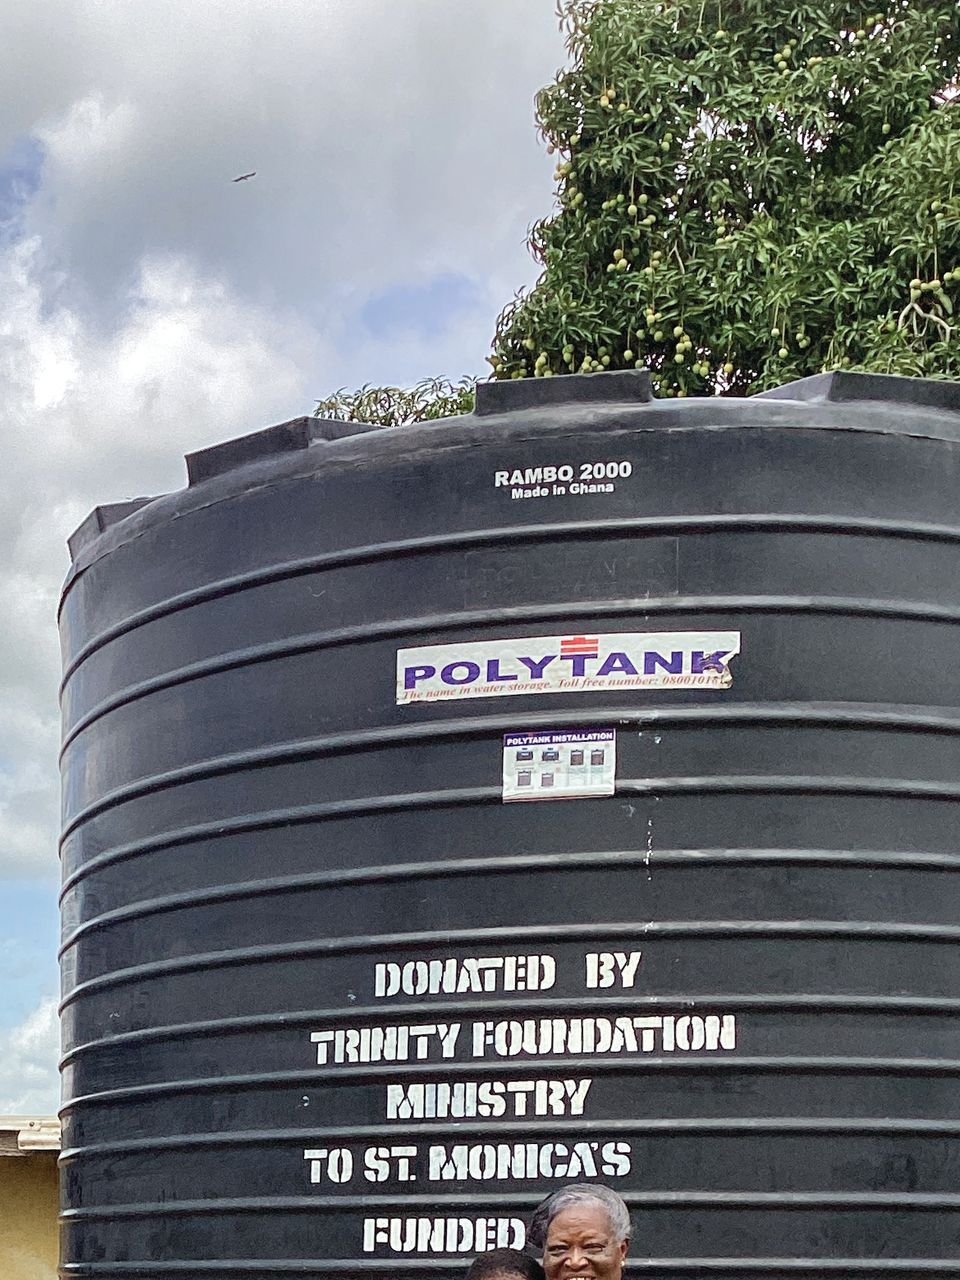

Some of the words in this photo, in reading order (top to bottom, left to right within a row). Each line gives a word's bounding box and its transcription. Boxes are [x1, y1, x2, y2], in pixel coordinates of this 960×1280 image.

[494, 465, 574, 487] RAMBO
[579, 461, 632, 480] 2000
[511, 487, 549, 499] Made
[553, 485, 566, 495] in
[569, 482, 614, 495] Ghana
[402, 690, 424, 699] The
[426, 688, 457, 698] name
[460, 686, 472, 694] in
[474, 684, 505, 694] water
[508, 681, 553, 693] storage.
[558, 678, 580, 688] Toll
[581, 677, 605, 688] free
[608, 676, 658, 686] number:
[403, 650, 735, 690] POLYTANK
[506, 736, 551, 746] POLYTANK
[552, 732, 613, 743] INSTALLATION
[374, 953, 557, 997] DONATED
[585, 951, 642, 989] BY
[310, 1023, 461, 1065] TRINITY
[472, 1014, 736, 1057] FOUNDATION
[386, 1078, 593, 1120] MINISTRY
[303, 1147, 354, 1184] TO
[363, 1145, 418, 1183] ST.
[428, 1142, 633, 1181] MONICA'S
[363, 1217, 527, 1253] FUNDED
